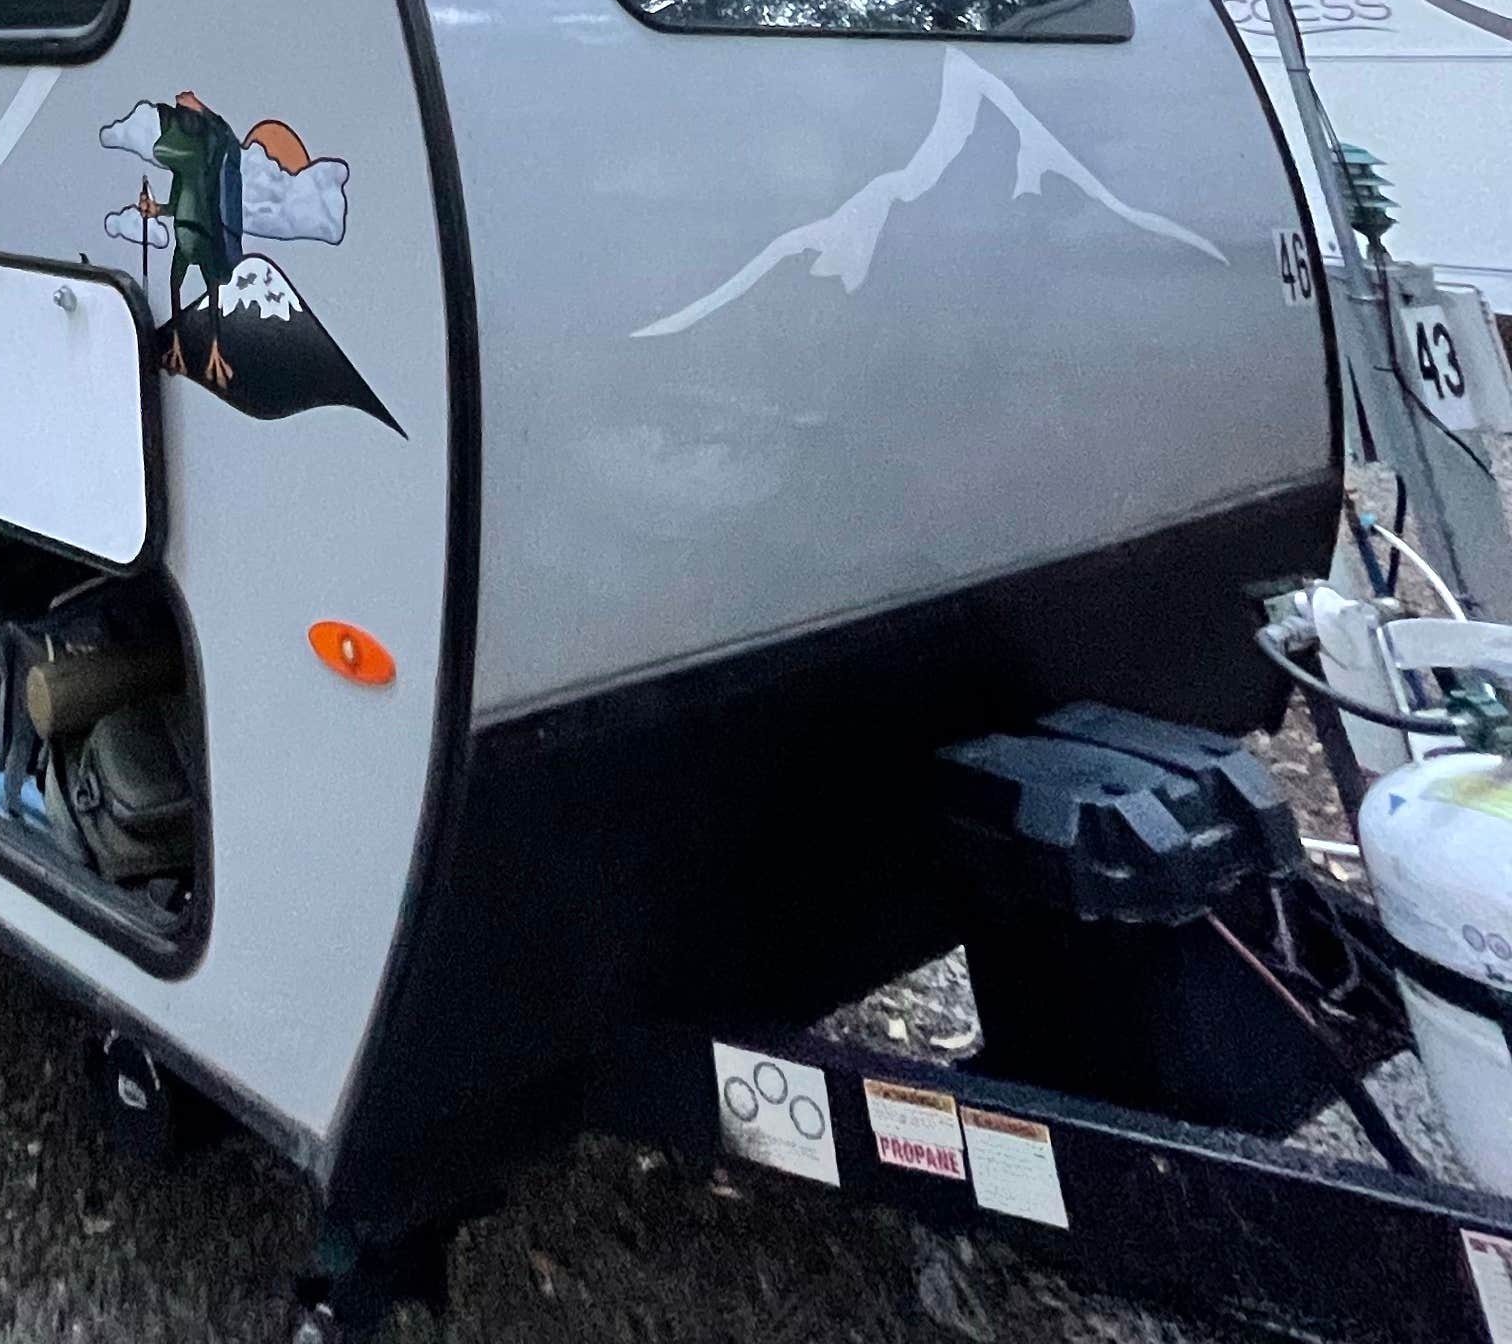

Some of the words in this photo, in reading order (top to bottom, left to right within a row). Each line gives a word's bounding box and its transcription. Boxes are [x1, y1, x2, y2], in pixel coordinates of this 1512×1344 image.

[1279, 231, 1313, 301] 46
[1416, 321, 1466, 400] 43
[879, 1134, 961, 1175] PROPANE
